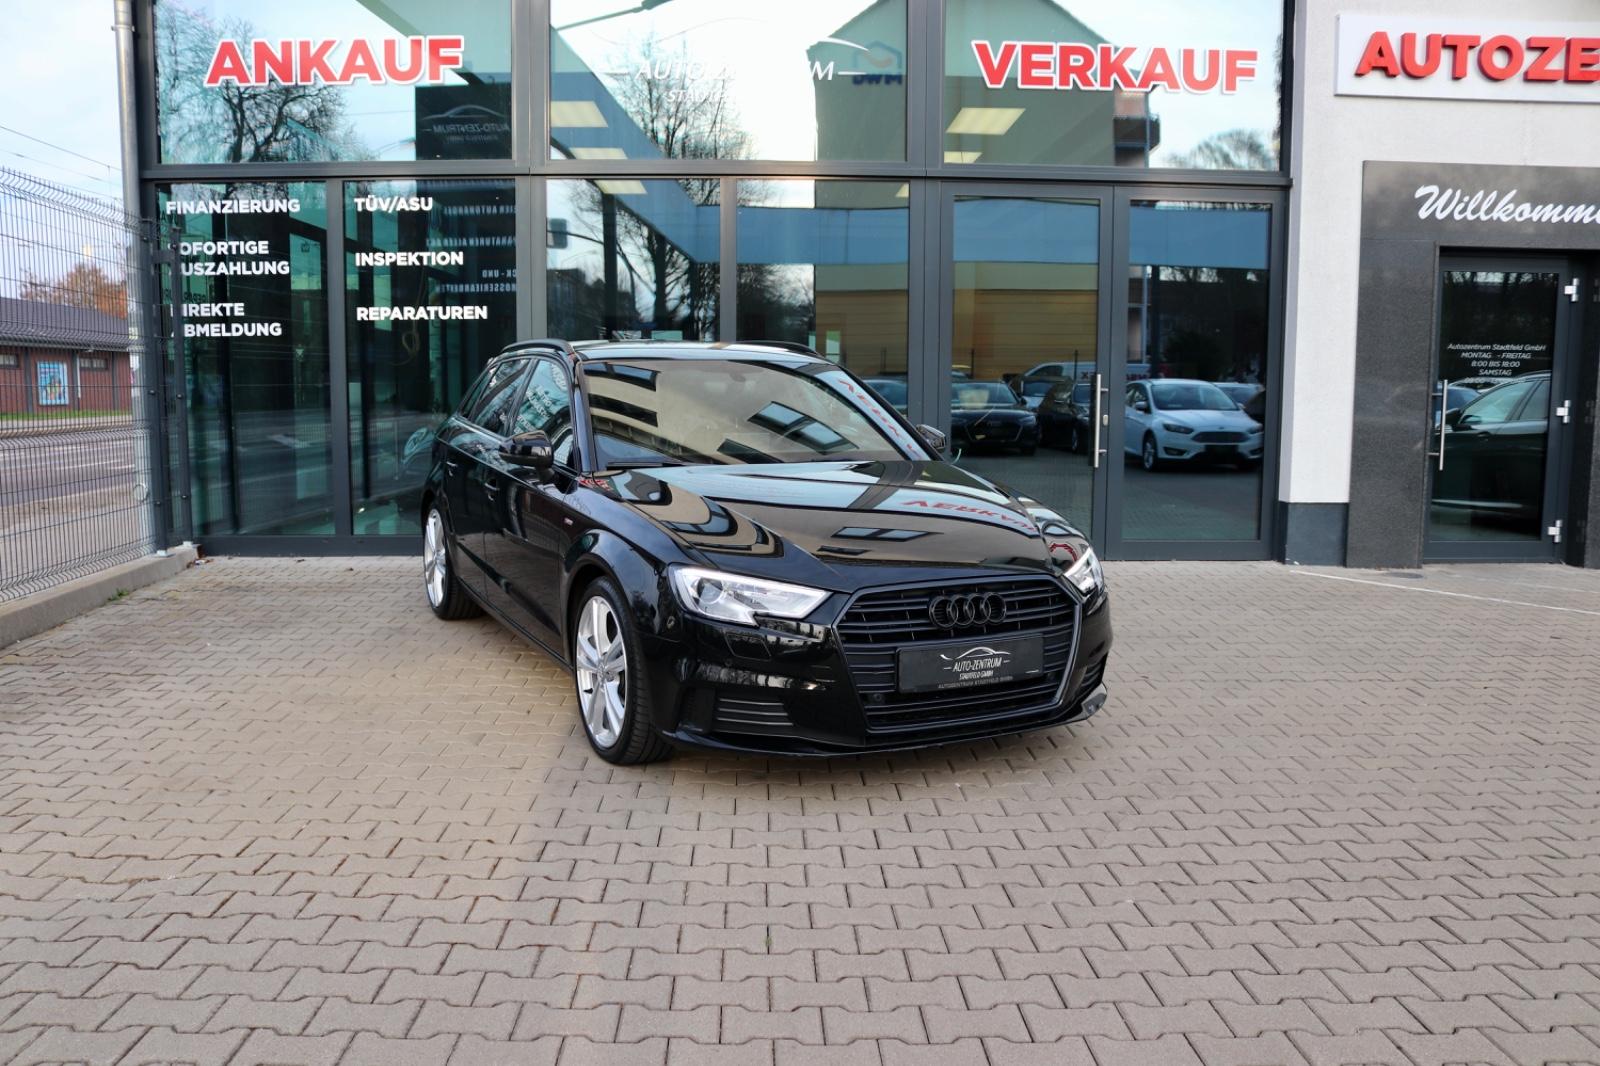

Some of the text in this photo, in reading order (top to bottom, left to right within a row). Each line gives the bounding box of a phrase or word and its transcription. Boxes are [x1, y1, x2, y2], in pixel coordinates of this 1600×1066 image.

[204, 35, 465, 87] ANKAUF
[1355, 31, 1600, 82] AUTOZE
[971, 40, 1258, 94] VERKAUF
[166, 199, 301, 214] FINANZIERUNG
[354, 194, 433, 213] TÜV/ASU
[168, 241, 269, 255] OFORTIGE
[355, 252, 464, 267] INSPEKTION
[169, 261, 290, 276] USZAHLUNG
[356, 306, 488, 321] REPARATUREN
[171, 323, 282, 337] BMELDUNG
[952, 657, 1002, 672] AUTO-ZENTRUM
